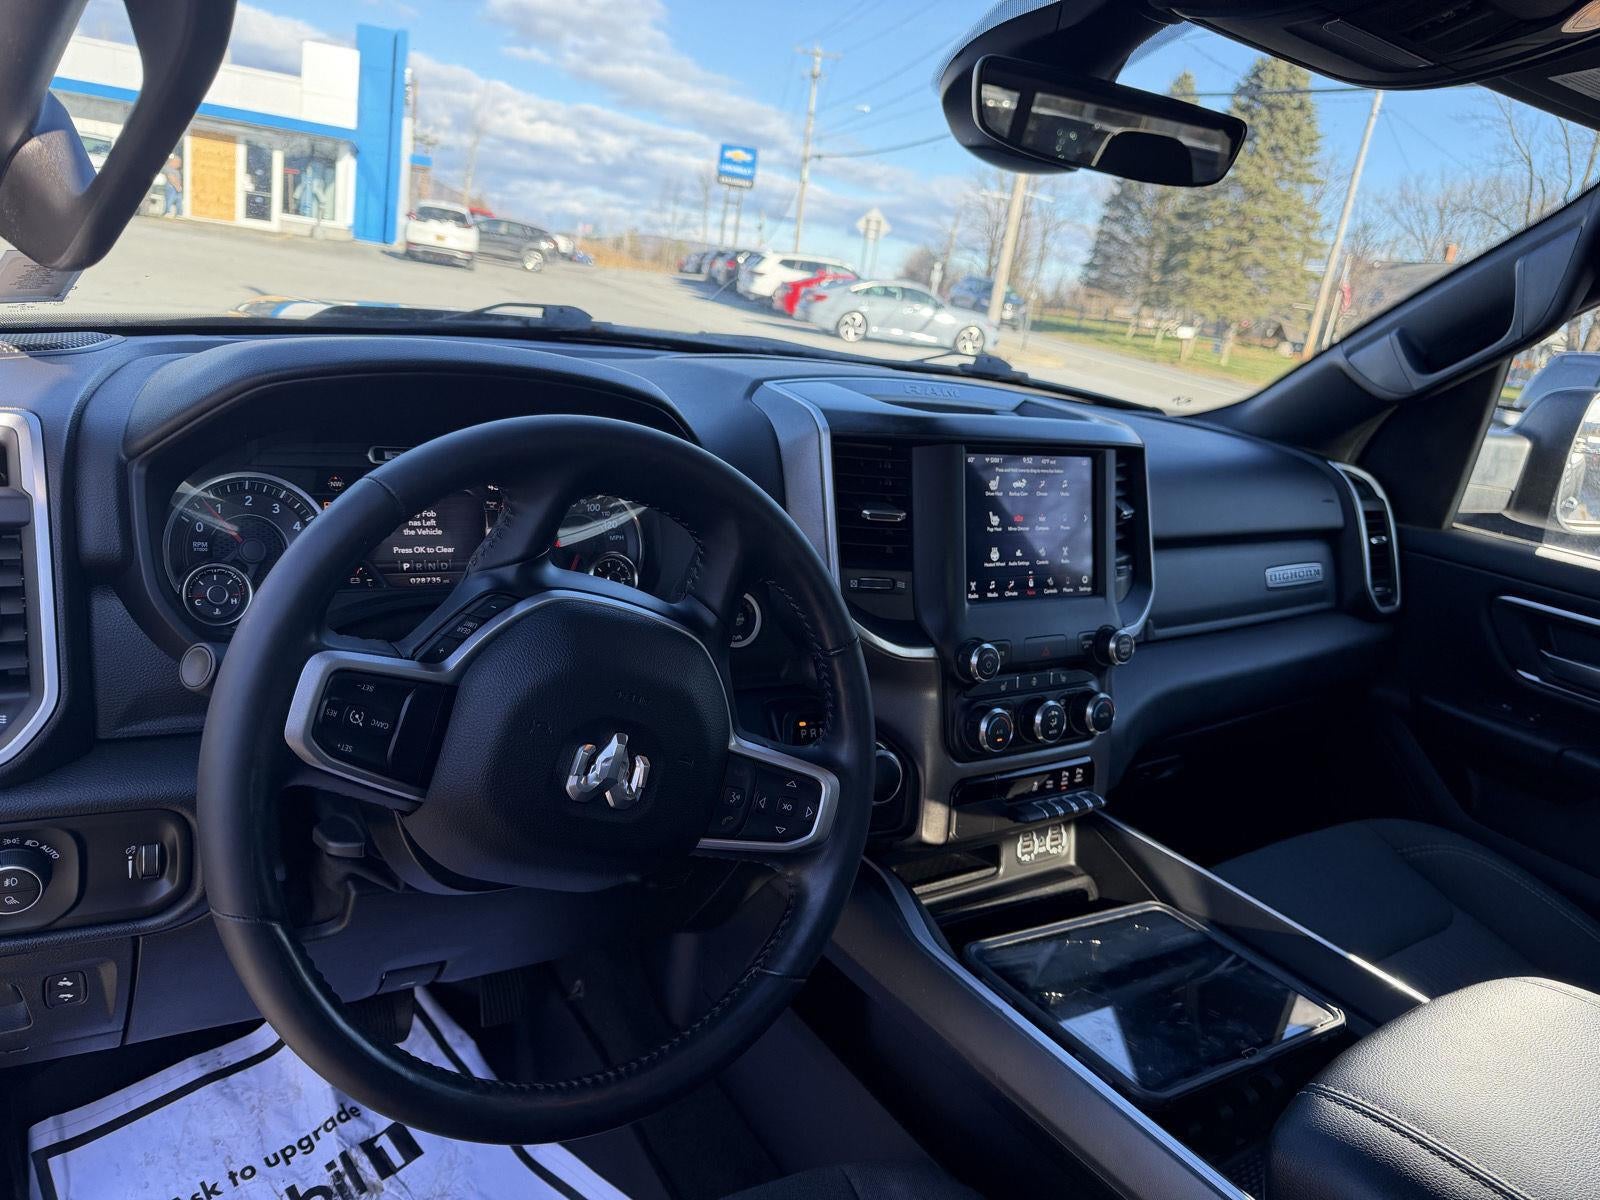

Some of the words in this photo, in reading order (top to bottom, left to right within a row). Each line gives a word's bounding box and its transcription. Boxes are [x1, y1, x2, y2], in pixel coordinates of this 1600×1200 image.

[903, 384, 960, 398] RAM
[244, 496, 252, 506] 2
[216, 504, 222, 514] 1
[272, 503, 280, 514] 3
[586, 504, 600, 512] 100
[196, 522, 204, 533] 0
[292, 521, 301, 532] 4
[403, 563, 410, 571] P
[428, 562, 436, 570] N
[441, 562, 448, 570] D
[326, 707, 338, 718] RES
[370, 720, 390, 730] CANC
[801, 729, 806, 739] P
[810, 728, 816, 738] R
[782, 802, 793, 811] OK
[40, 844, 60, 860] AUTO
[172, 1180, 224, 1200] sk
[228, 1165, 256, 1187] to
[264, 1103, 361, 1168] upgrade
